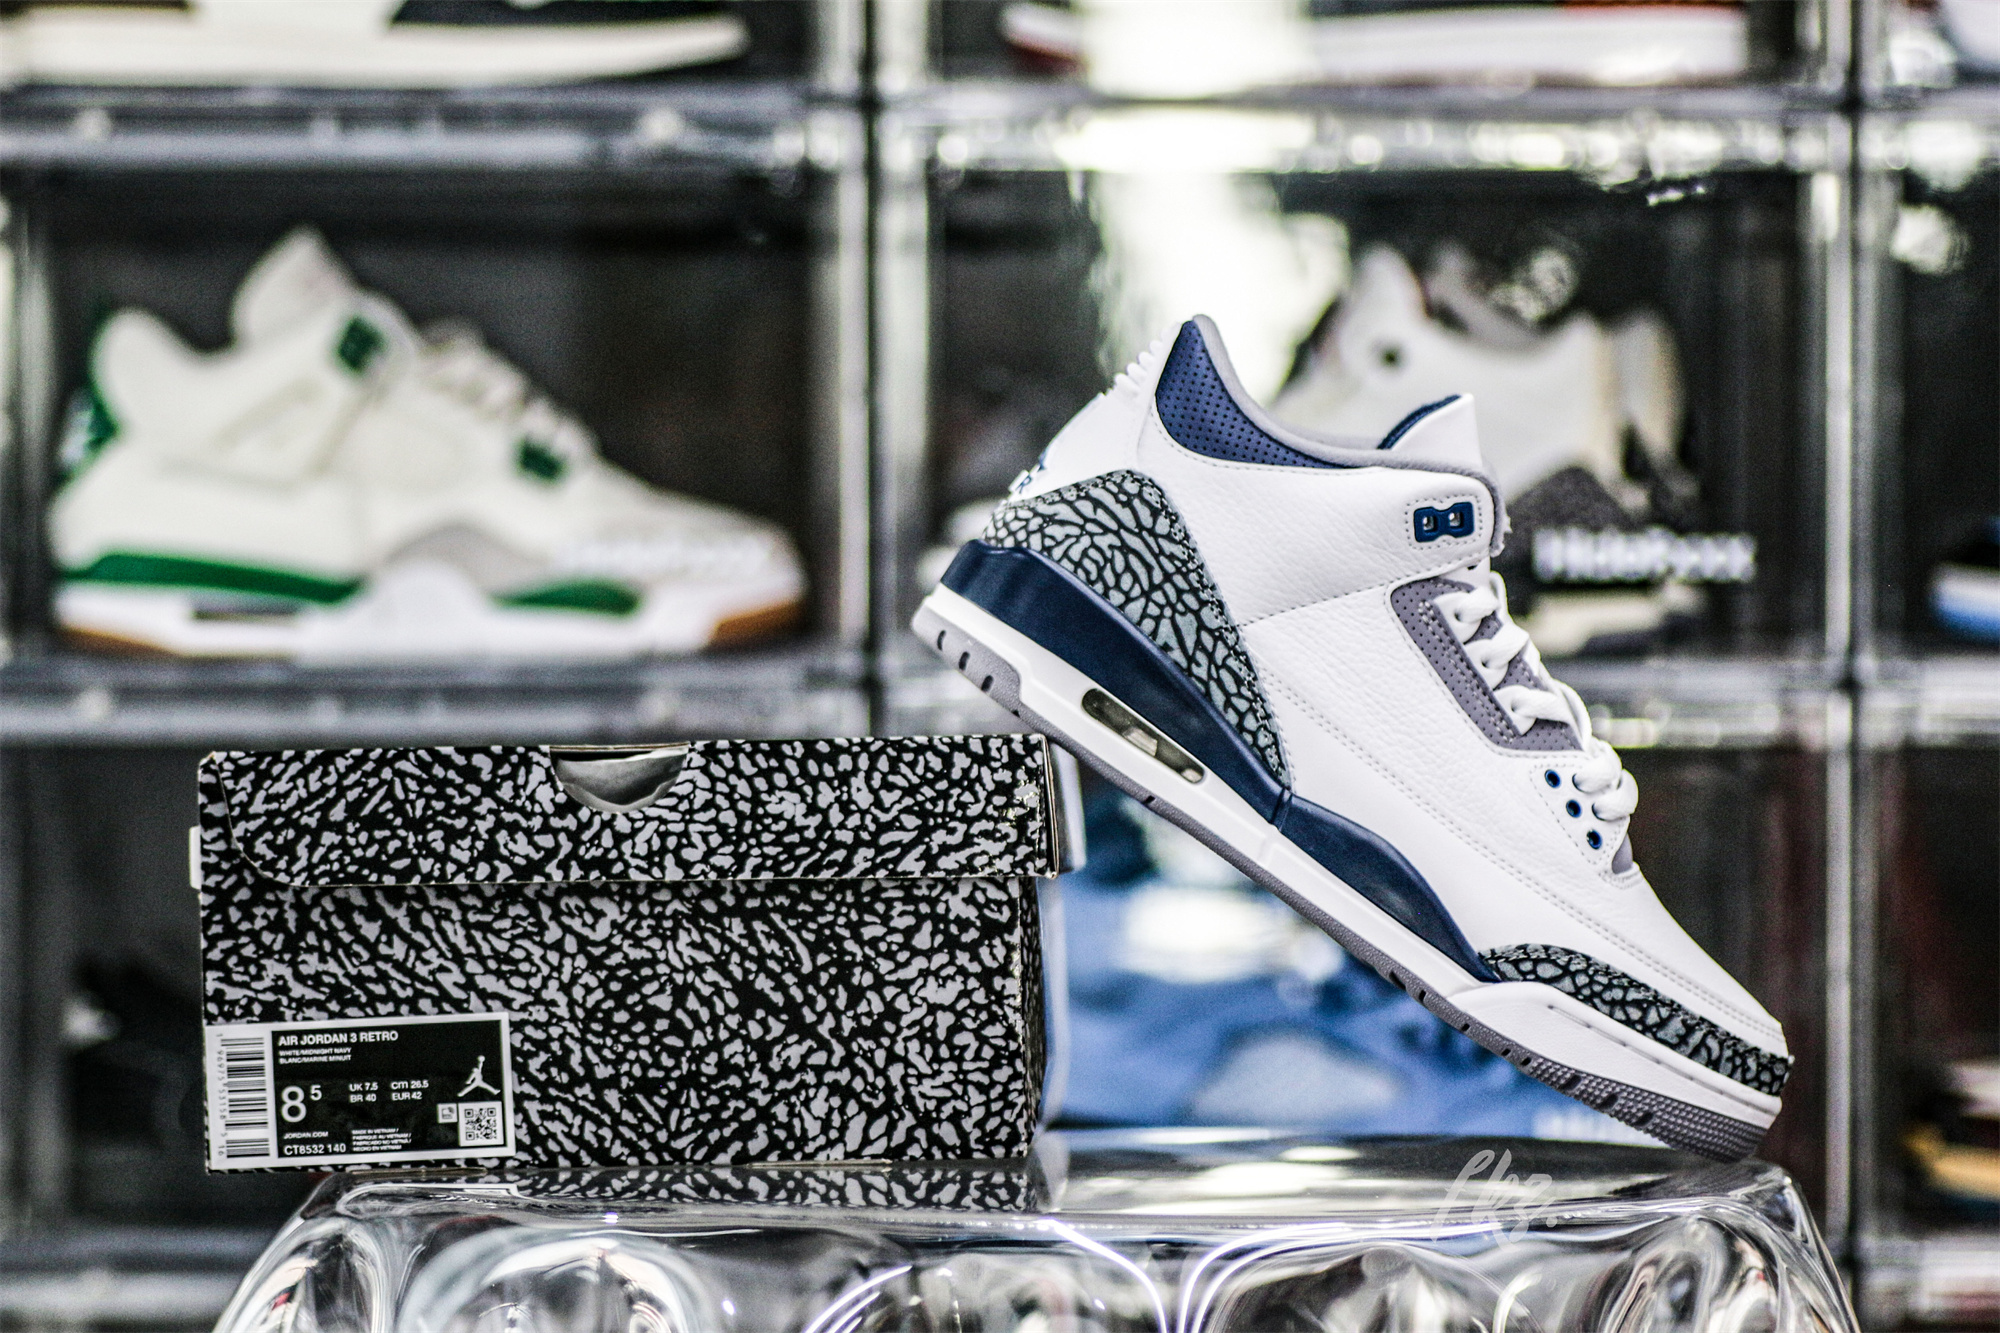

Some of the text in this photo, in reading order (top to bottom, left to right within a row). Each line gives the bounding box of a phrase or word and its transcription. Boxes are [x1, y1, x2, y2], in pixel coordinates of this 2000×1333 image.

[278, 1031, 398, 1046] AIR JORDAN 3 RETRO
[279, 1048, 333, 1056] WHITE/MIDNIGHT
[279, 1054, 351, 1064] BLANC/MARINE MINUIT
[349, 1082, 378, 1092] UK 7.5
[410, 1080, 429, 1089] 26.5
[350, 1093, 377, 1102] BR 40
[391, 1091, 422, 1101] EUR 42
[281, 1084, 322, 1122] 8 5
[283, 1131, 328, 1140] JORDAN.COM
[284, 1143, 347, 1156] CT8532 140
